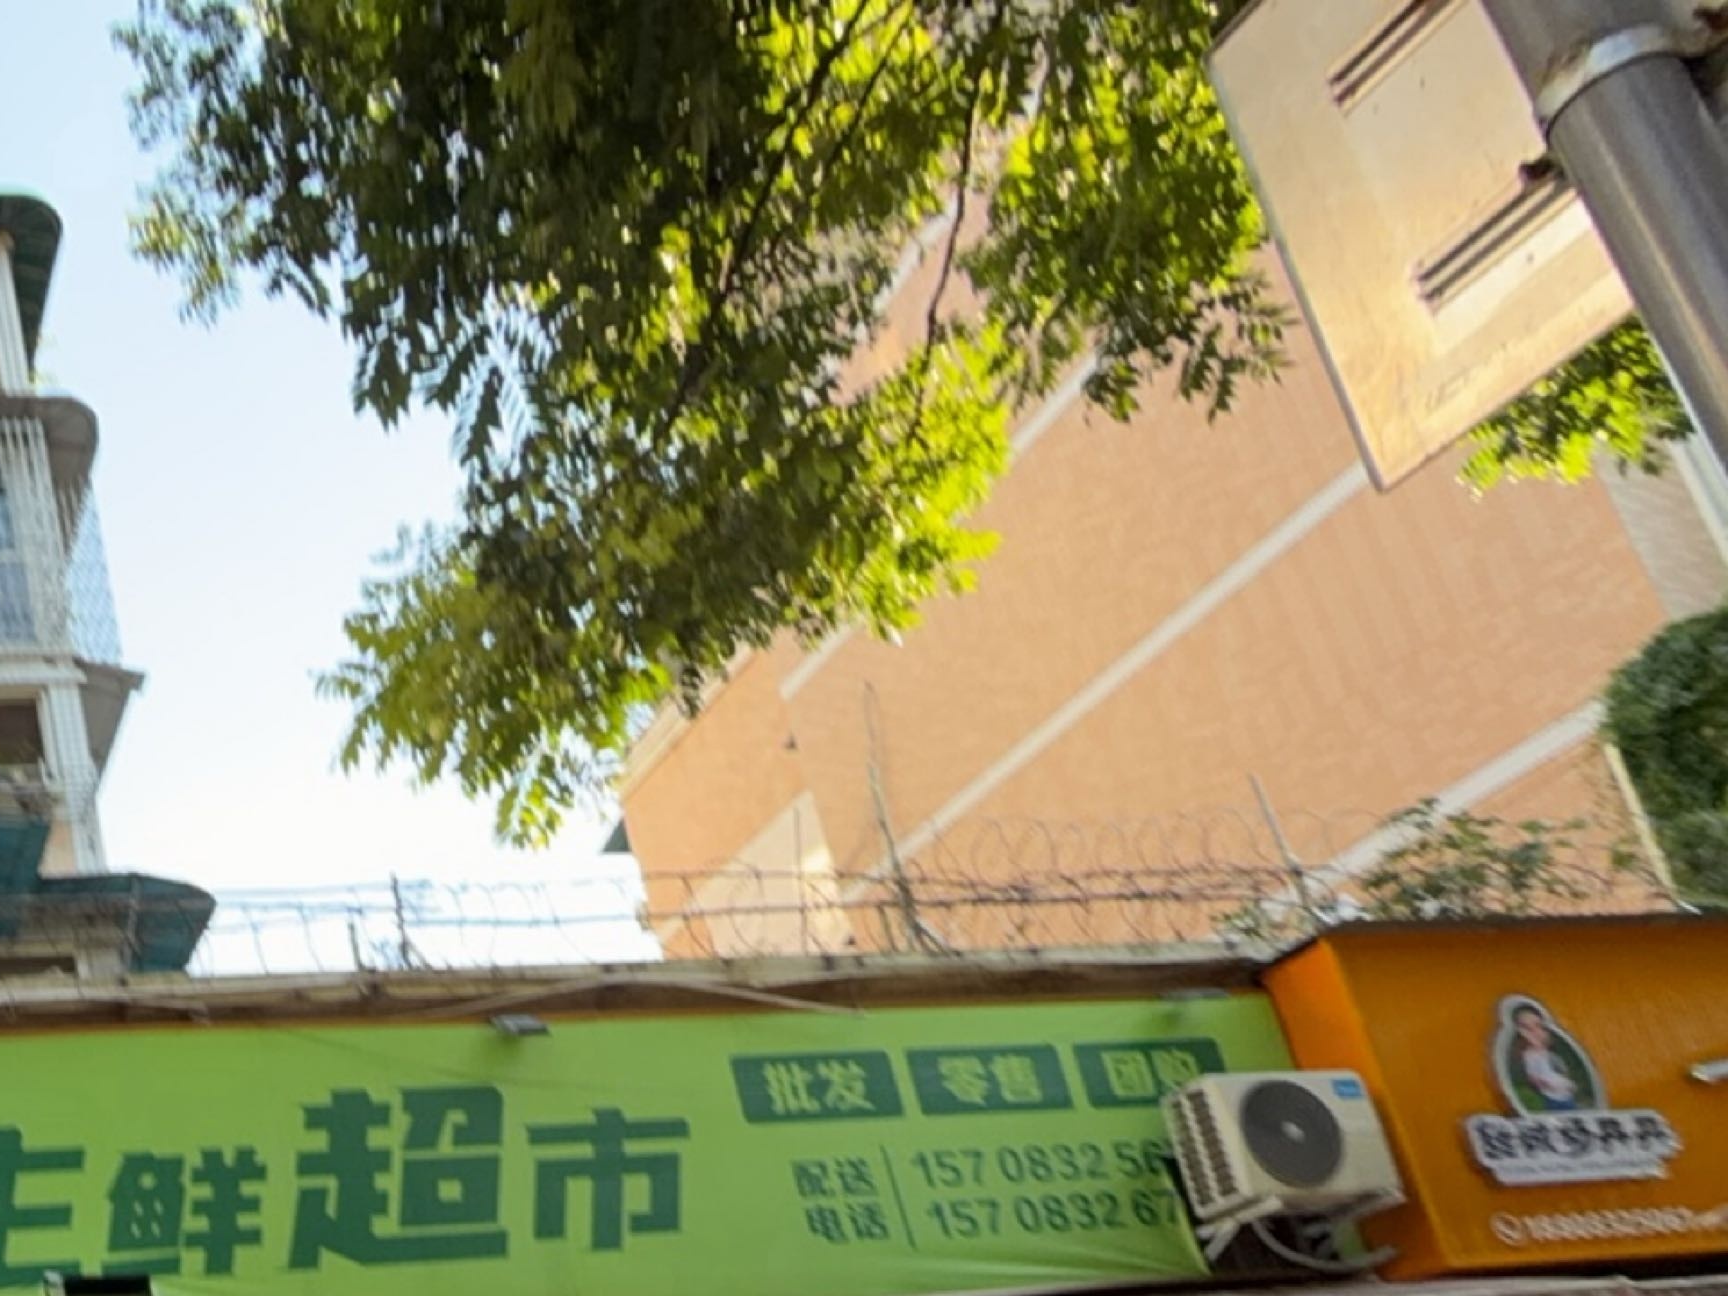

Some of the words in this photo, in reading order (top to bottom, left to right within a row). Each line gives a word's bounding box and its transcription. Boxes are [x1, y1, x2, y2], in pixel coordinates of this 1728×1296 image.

[762, 1061, 877, 1116] 批发
[939, 1054, 1043, 1106] 零售
[791, 1156, 879, 1200] 配送
[805, 1205, 891, 1245] 电话
